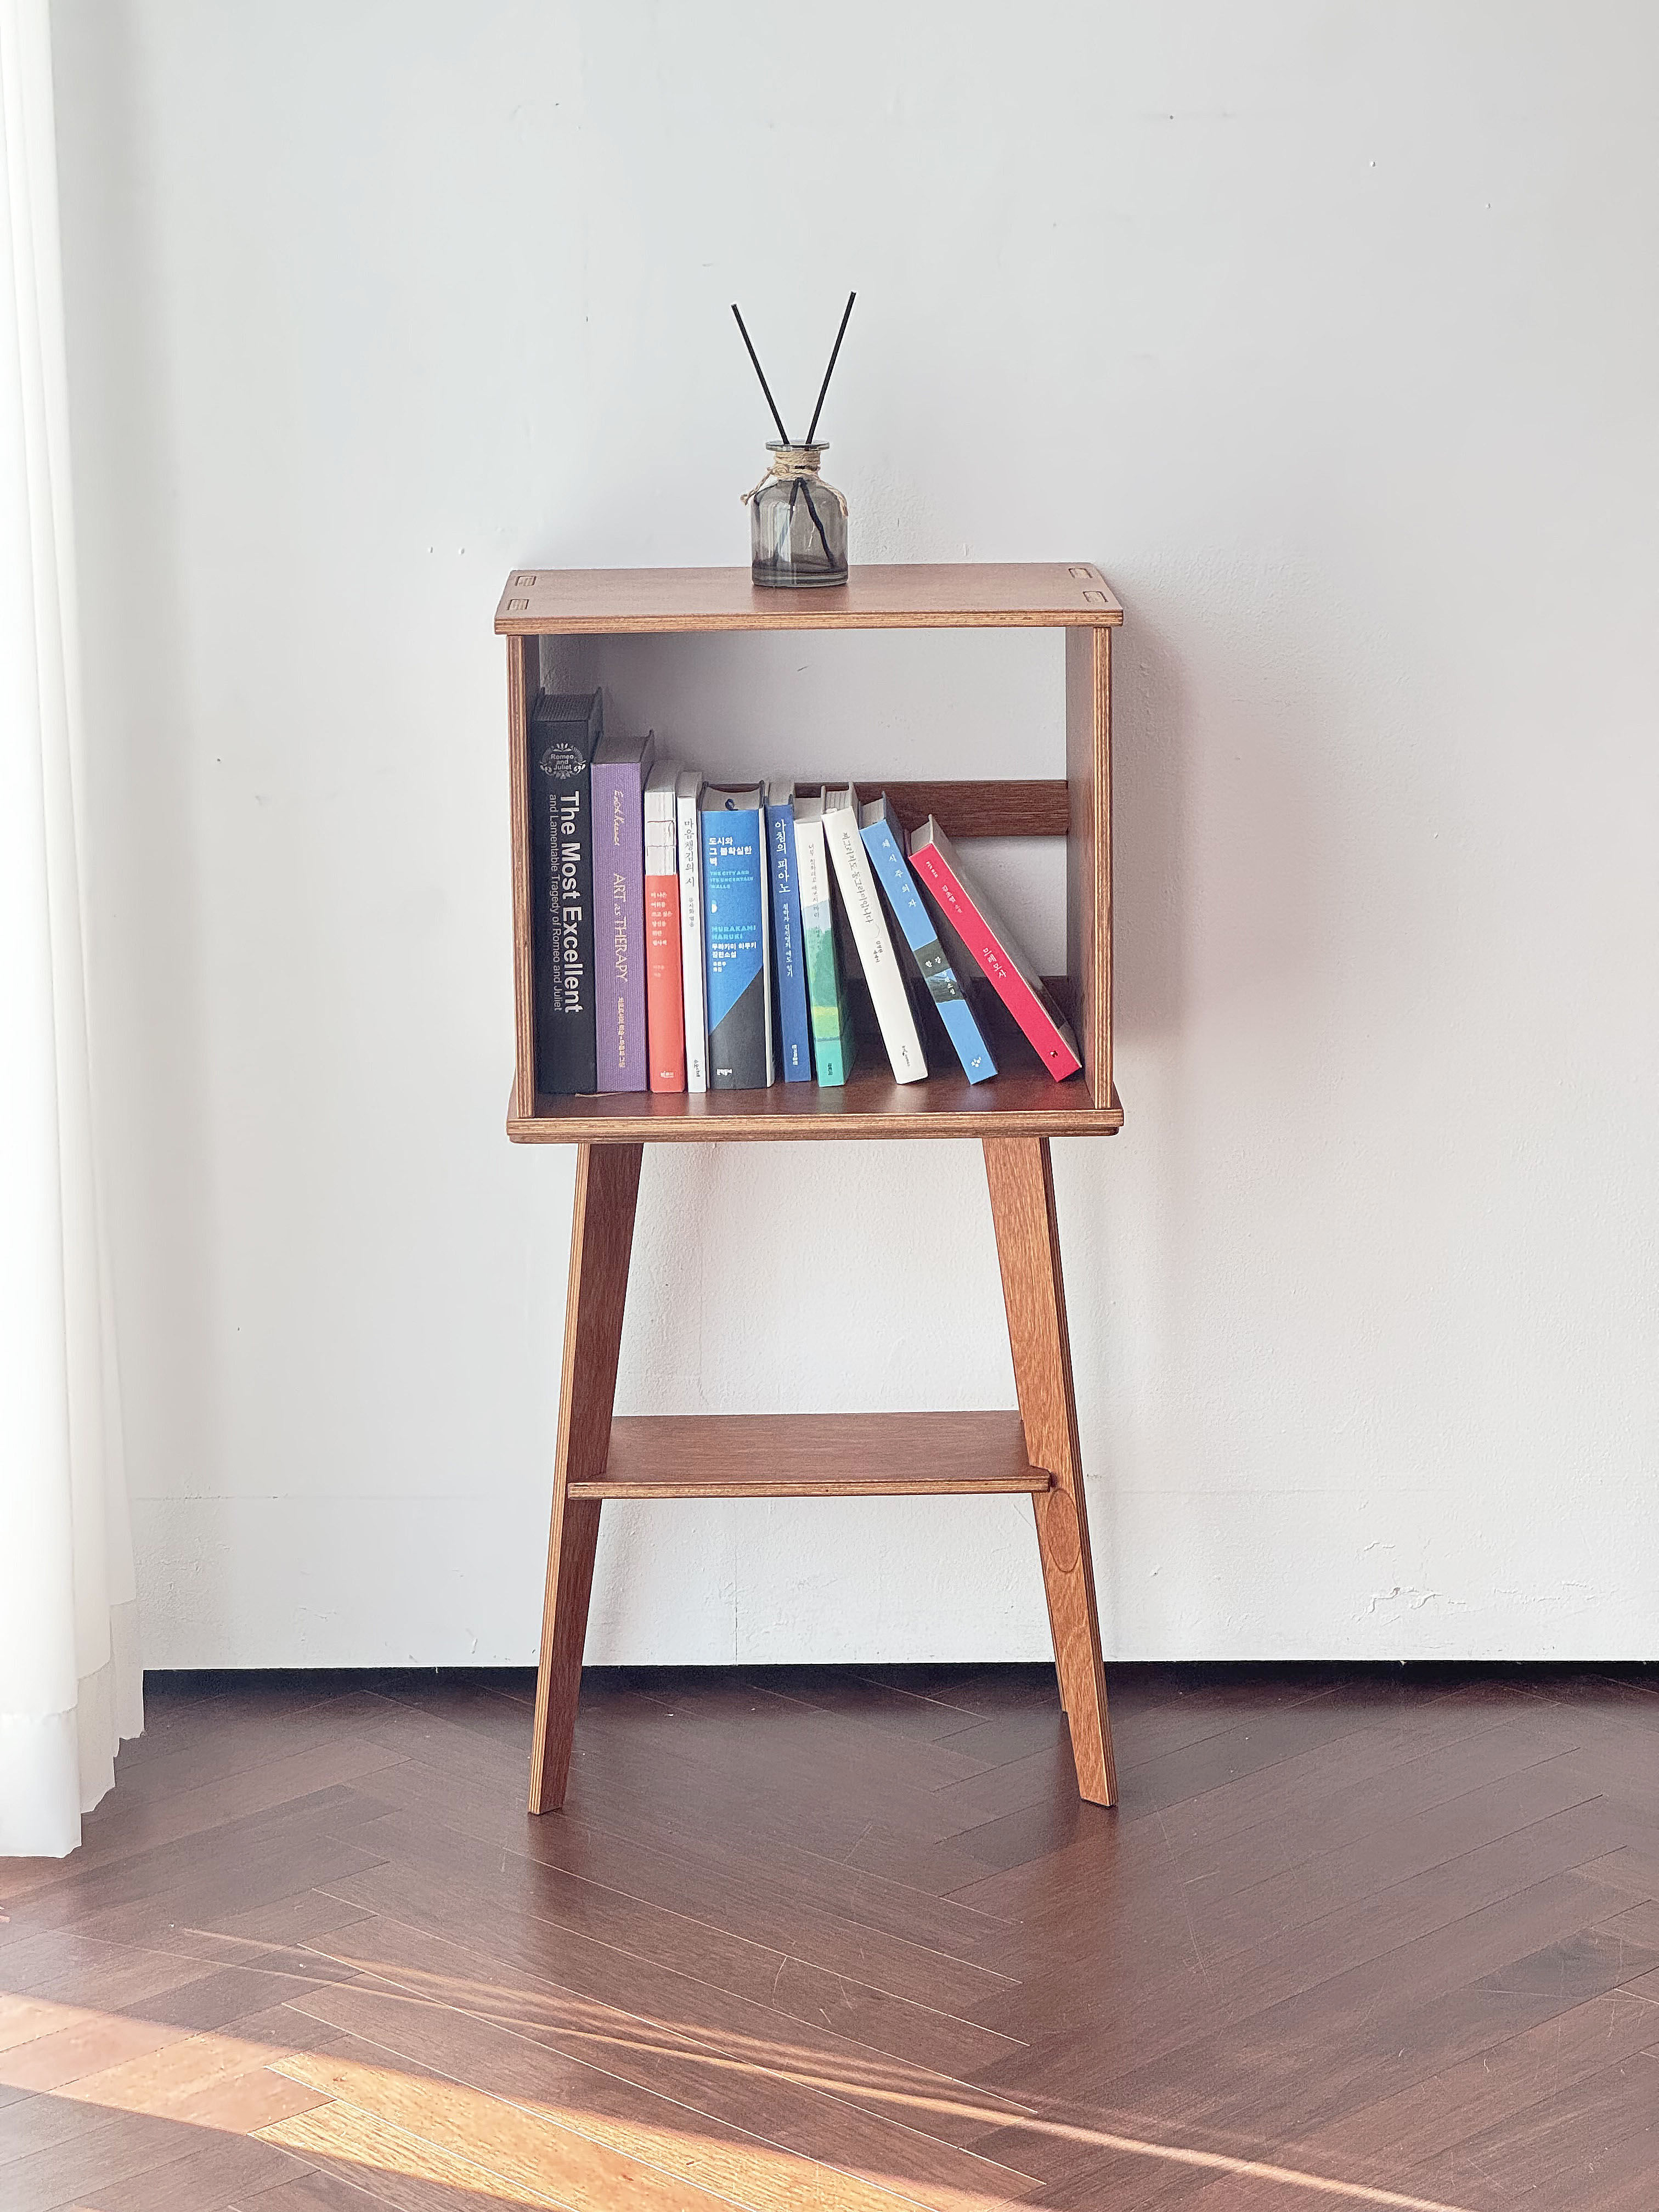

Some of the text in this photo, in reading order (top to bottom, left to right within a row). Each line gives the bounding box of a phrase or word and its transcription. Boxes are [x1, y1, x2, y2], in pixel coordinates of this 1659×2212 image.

[684, 818, 695, 887] 마음챙김의 시
[708, 837, 733, 845] 도시와
[720, 845, 752, 856] 불확실한
[775, 819, 791, 893] 아침의 피아노
[709, 857, 718, 866] 벽
[882, 838, 917, 908] 채식주의자
[560, 791, 583, 1013] The Most Excellent
[614, 873, 626, 902] ART
[851, 871, 874, 923] 동그라미입니다
[549, 794, 562, 1012] and Lamentable Tragedy of Romeo and Juliet
[614, 904, 620, 916] as
[614, 916, 628, 983] THERAPY
[738, 941, 757, 950] 하루키
[785, 950, 793, 963] 애도
[786, 964, 793, 978] 일기
[983, 947, 1007, 979] 므레모사
